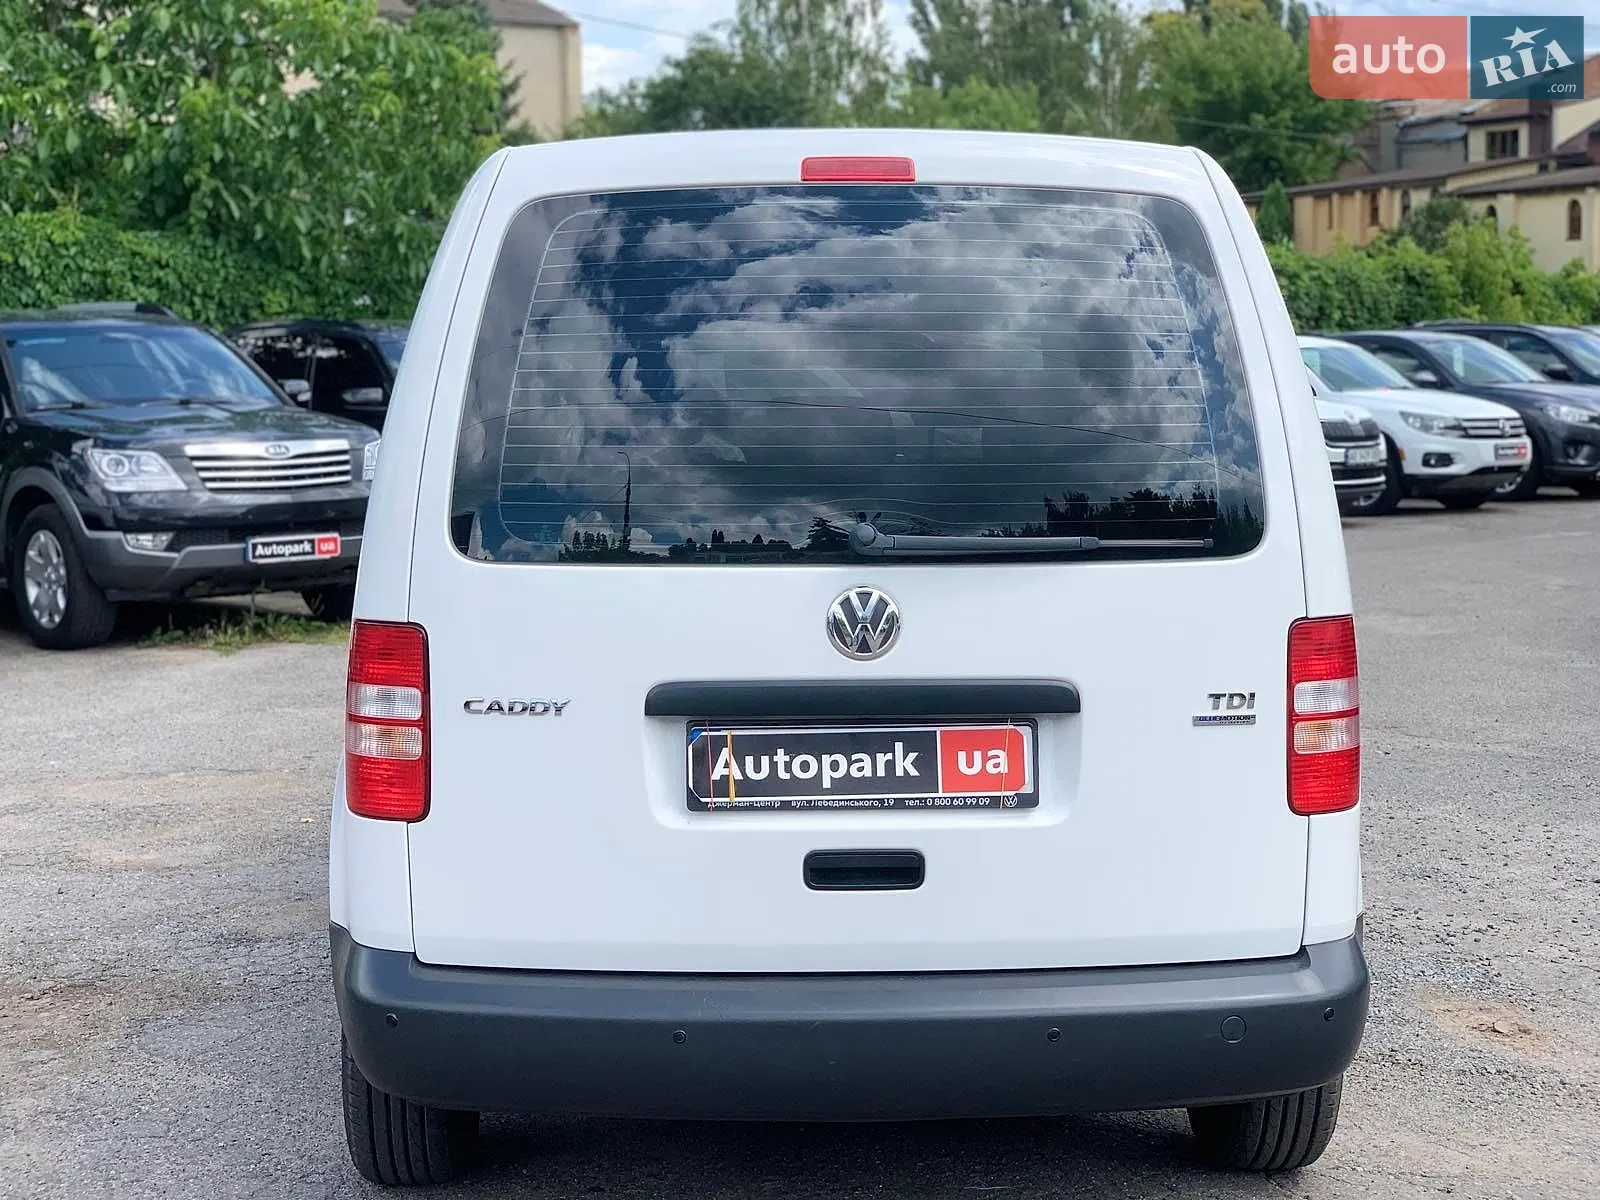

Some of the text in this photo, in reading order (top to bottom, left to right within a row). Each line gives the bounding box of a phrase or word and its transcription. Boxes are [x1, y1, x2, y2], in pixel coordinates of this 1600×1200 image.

[255, 540, 336, 557] Autopark ua
[463, 698, 573, 717] CADDY
[1207, 692, 1256, 710] TDI
[711, 741, 1009, 789] Autopark ua
[791, 800, 809, 808] вул.
[811, 798, 881, 808] Лебединського,
[883, 798, 895, 806] 19
[926, 798, 932, 806] 0
[934, 798, 951, 806] 800
[952, 797, 964, 806] 60
[965, 797, 978, 806] 99
[978, 797, 990, 805] 09
